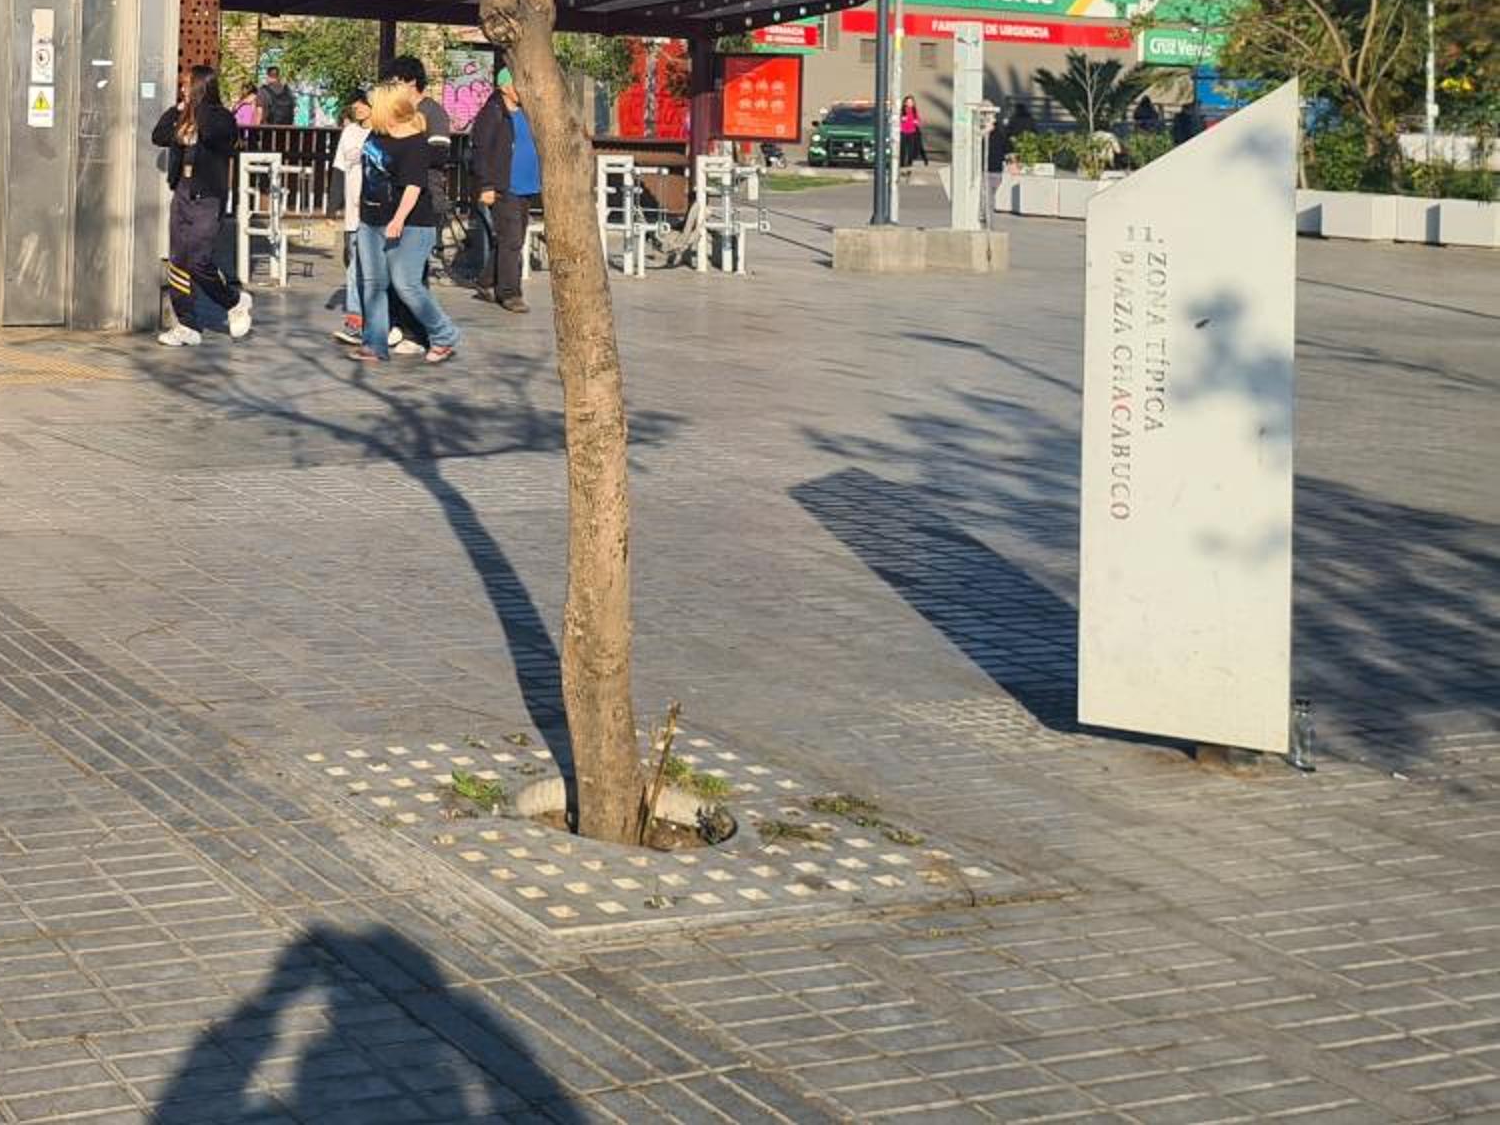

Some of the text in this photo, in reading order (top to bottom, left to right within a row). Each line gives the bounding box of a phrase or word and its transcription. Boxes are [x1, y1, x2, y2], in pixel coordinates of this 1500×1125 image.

[1149, 37, 1178, 55] Cruz
[1144, 251, 1171, 432] ZONA TÍPICA
[1110, 343, 1134, 521] CHACABUCO
